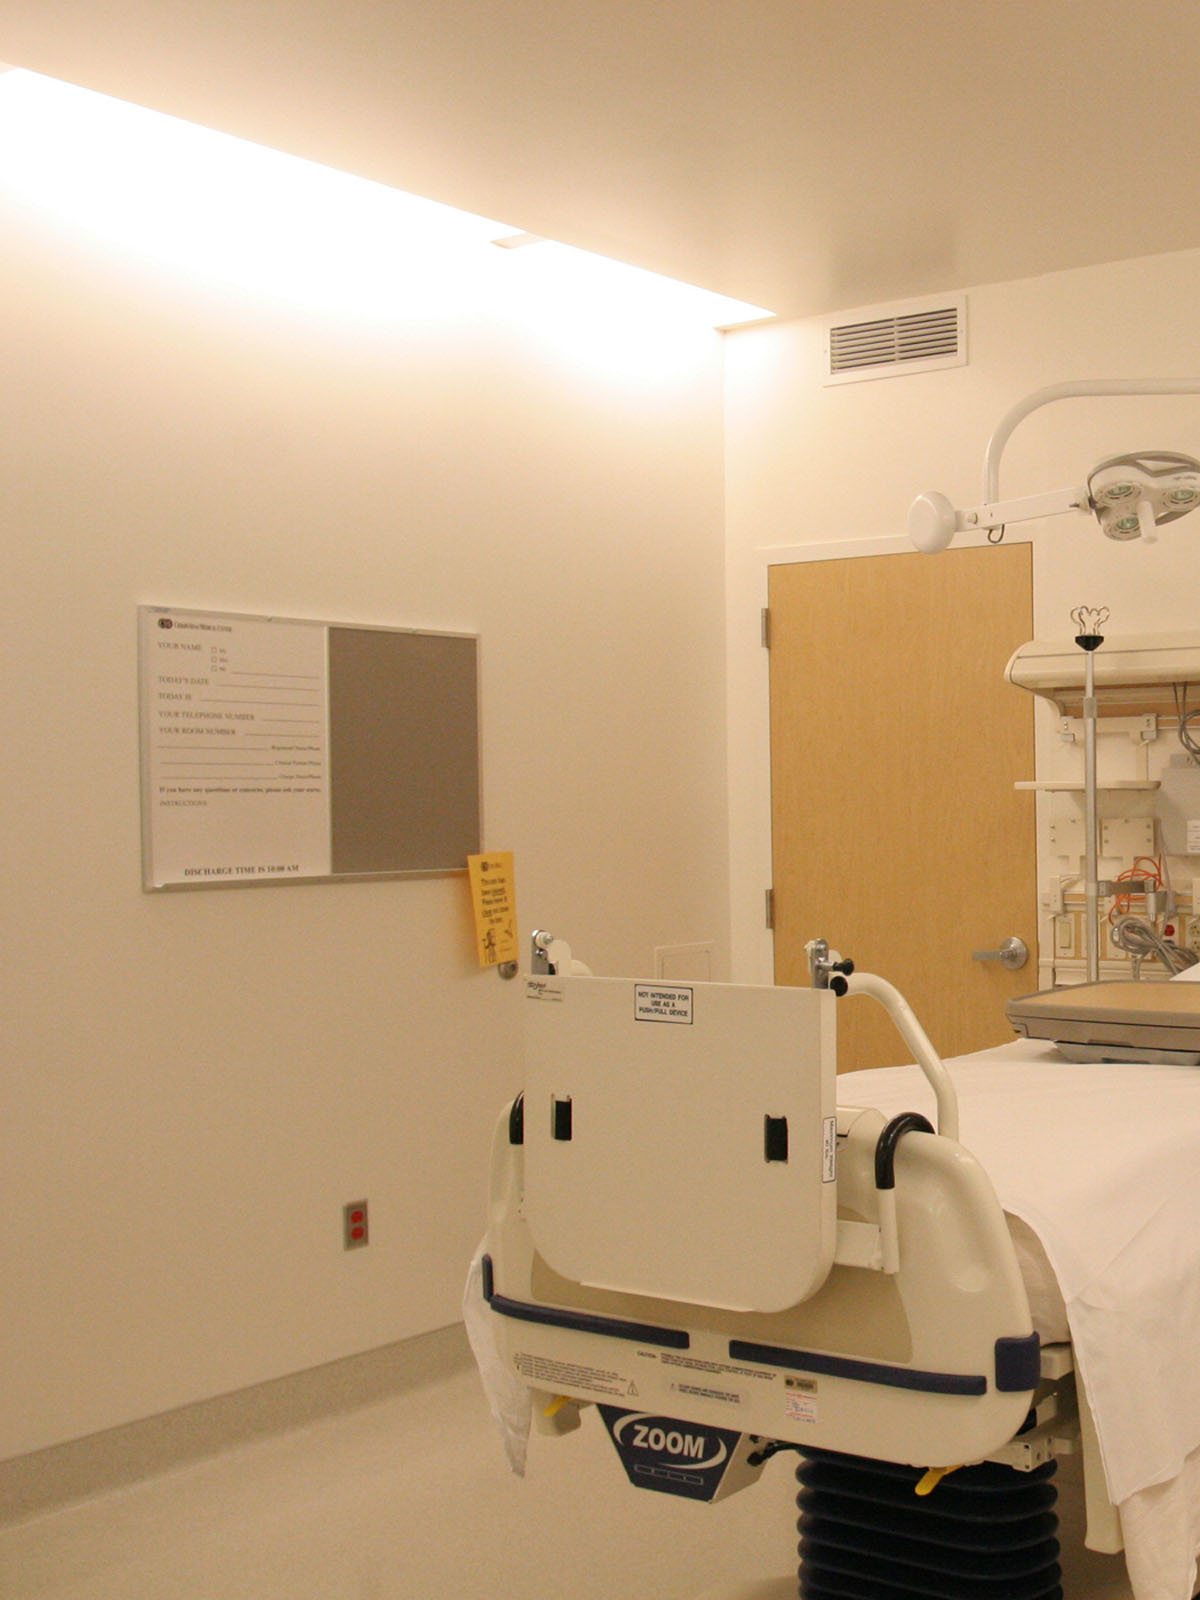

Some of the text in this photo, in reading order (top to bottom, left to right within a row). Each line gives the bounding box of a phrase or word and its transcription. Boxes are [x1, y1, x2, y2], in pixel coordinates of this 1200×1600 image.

[158, 710, 179, 718] YOUR
[181, 711, 223, 720] TELEPHONE
[158, 727, 179, 735] YOUR
[184, 867, 232, 876] DISCHARGE
[235, 866, 255, 874] TIME
[287, 864, 299, 872] AM
[650, 992, 676, 1000] INTENDED
[639, 1006, 688, 1017] PUSH/PULL DEVICE
[632, 1424, 705, 1459] ZOOM
